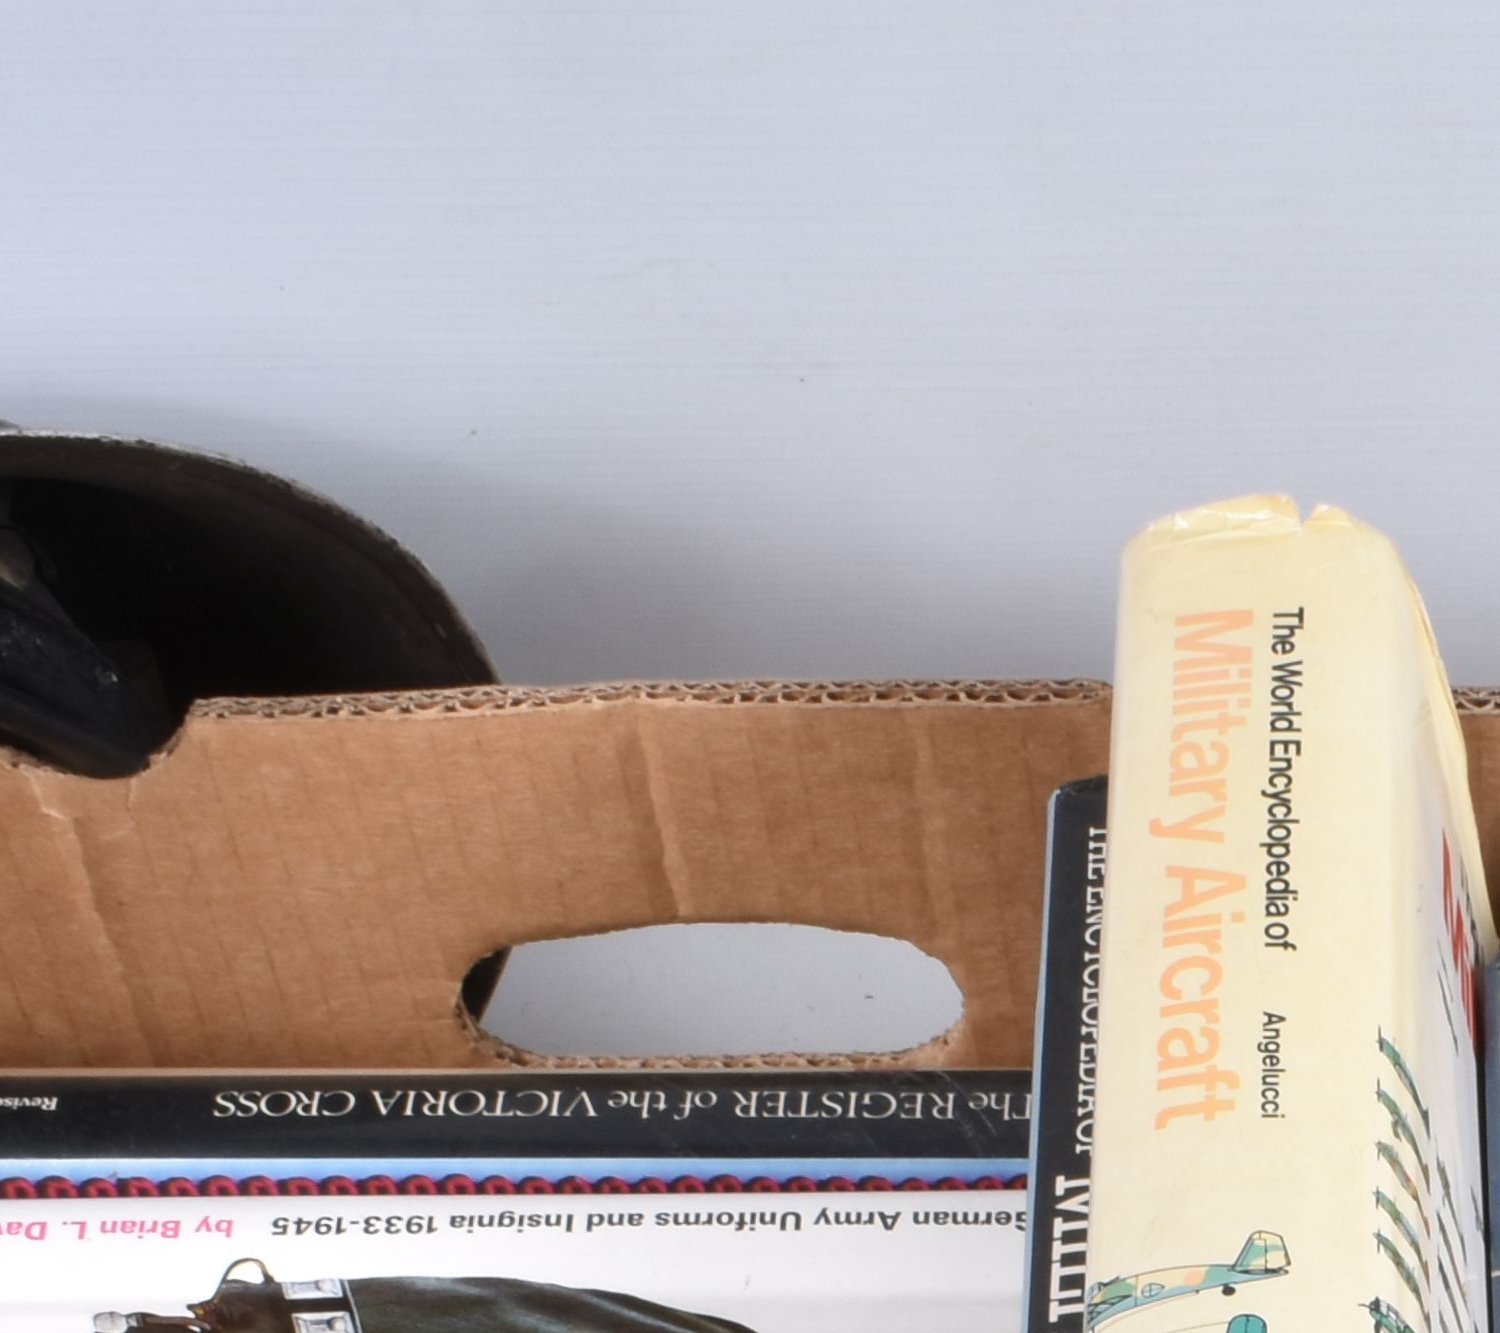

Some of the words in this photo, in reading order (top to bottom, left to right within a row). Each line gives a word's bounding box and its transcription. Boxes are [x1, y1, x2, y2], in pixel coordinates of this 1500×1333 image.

[1272, 606, 1304, 655] The
[1270, 660, 1303, 733] World
[1149, 609, 1255, 846] Military
[1261, 739, 1301, 917] Encyclopedia
[1264, 919, 1298, 952] of
[1154, 864, 1248, 1131] Aircraft
[1259, 1010, 1287, 1119] Angelucci
[213, 1089, 357, 1119] CROSS
[373, 1089, 598, 1120] VICTORIA
[608, 1088, 667, 1119] the
[673, 1088, 717, 1122] of
[732, 1089, 956, 1120] REGISTER
[967, 1090, 1032, 1121] The
[61, 1219, 88, 1241] L.
[99, 1218, 181, 1240] Brian
[195, 1215, 235, 1239] by
[270, 1213, 438, 1237] 1933-1945
[449, 1208, 575, 1235] Insignia
[585, 1211, 645, 1233] and
[655, 1210, 802, 1234] Uniforms
[815, 1206, 902, 1232] Army
[911, 1210, 1028, 1232] German
